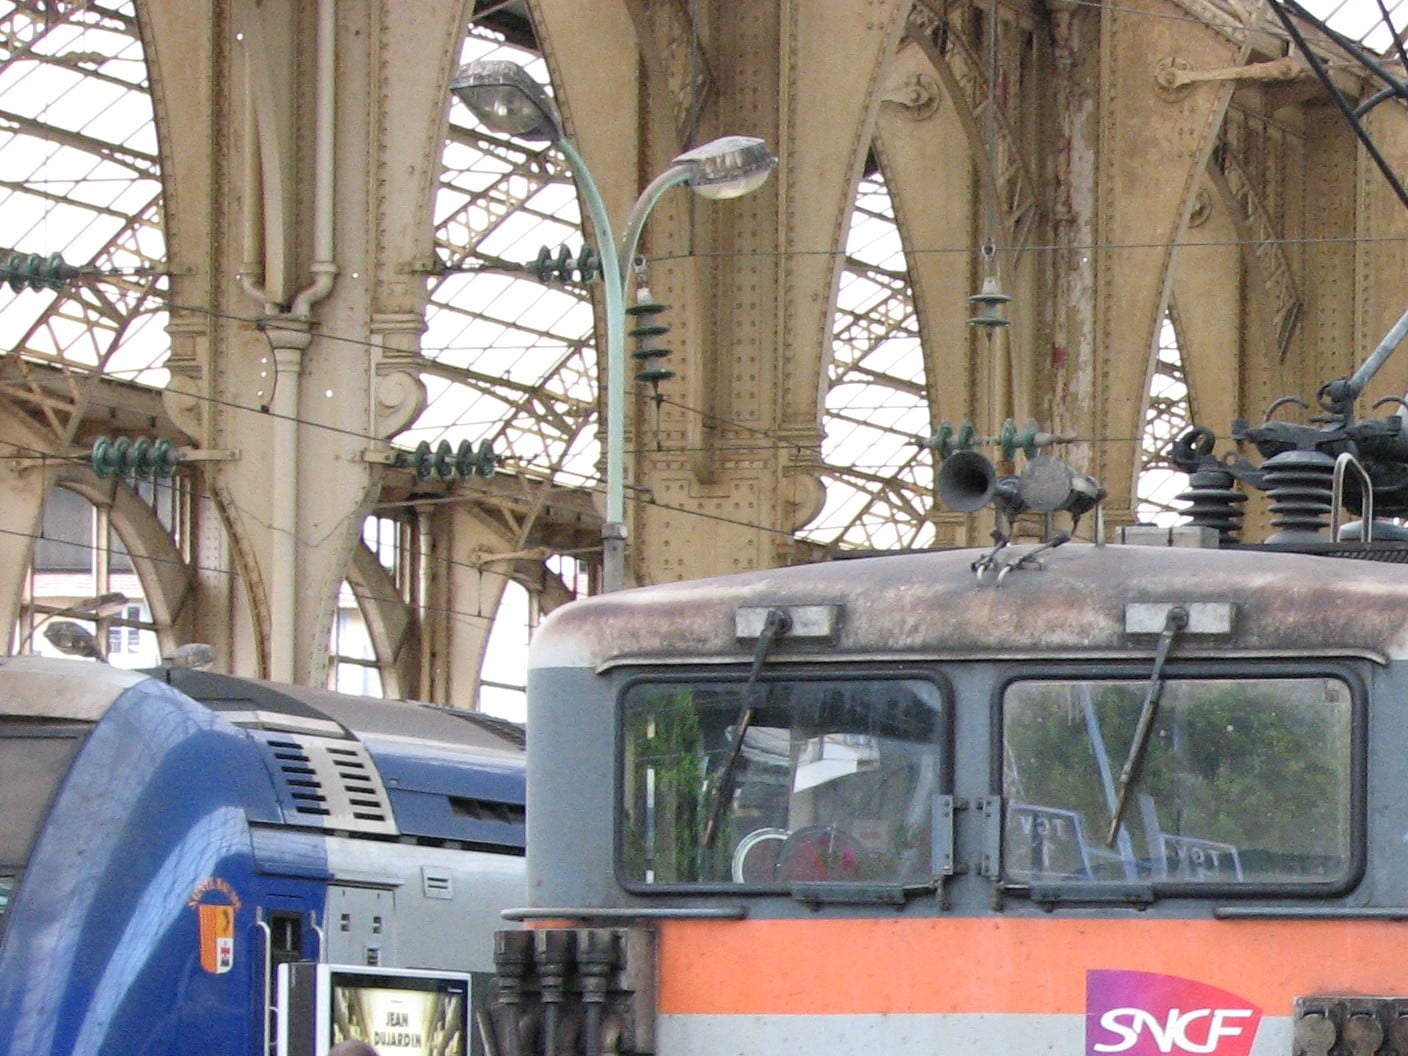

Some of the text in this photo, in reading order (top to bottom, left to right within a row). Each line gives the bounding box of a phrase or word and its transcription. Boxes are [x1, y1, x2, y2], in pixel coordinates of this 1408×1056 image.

[386, 1011, 408, 1027] JEAN
[1093, 1007, 1253, 1053] SNCF
[374, 1031, 421, 1048] DUJARDIN
